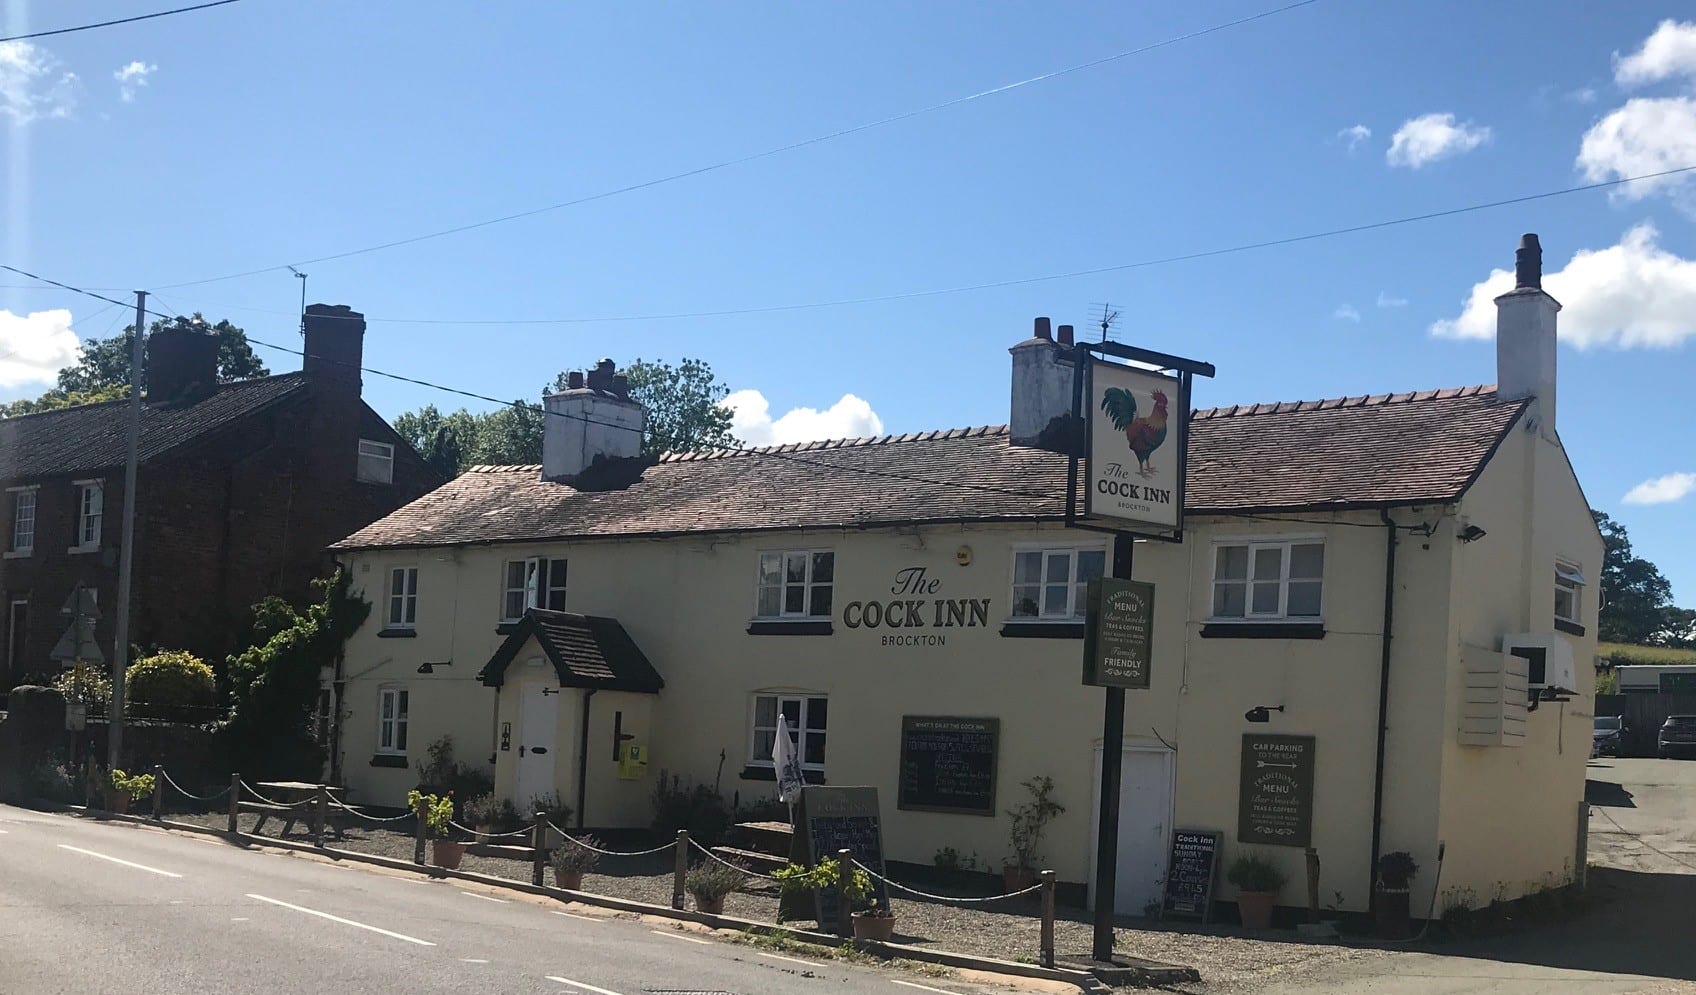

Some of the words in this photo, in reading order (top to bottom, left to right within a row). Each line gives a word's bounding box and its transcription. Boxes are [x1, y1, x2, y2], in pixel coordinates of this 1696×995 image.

[1103, 462, 1129, 479] The
[1097, 479, 1140, 500] COCK
[1143, 486, 1170, 504] INN
[1117, 501, 1151, 512] BROCKTON
[891, 567, 941, 595] The
[1114, 602, 1137, 612] MENU
[843, 600, 925, 628] COCK
[933, 598, 991, 628] INN
[881, 635, 946, 646] BROCKTON
[1104, 657, 1141, 669] FRIENDLY
[1253, 743, 1269, 751] CAR
[1270, 744, 1304, 753] PARKING
[1262, 784, 1289, 794] MENU
[1177, 834, 1198, 843] Cock
[1200, 836, 1214, 844] Inn
